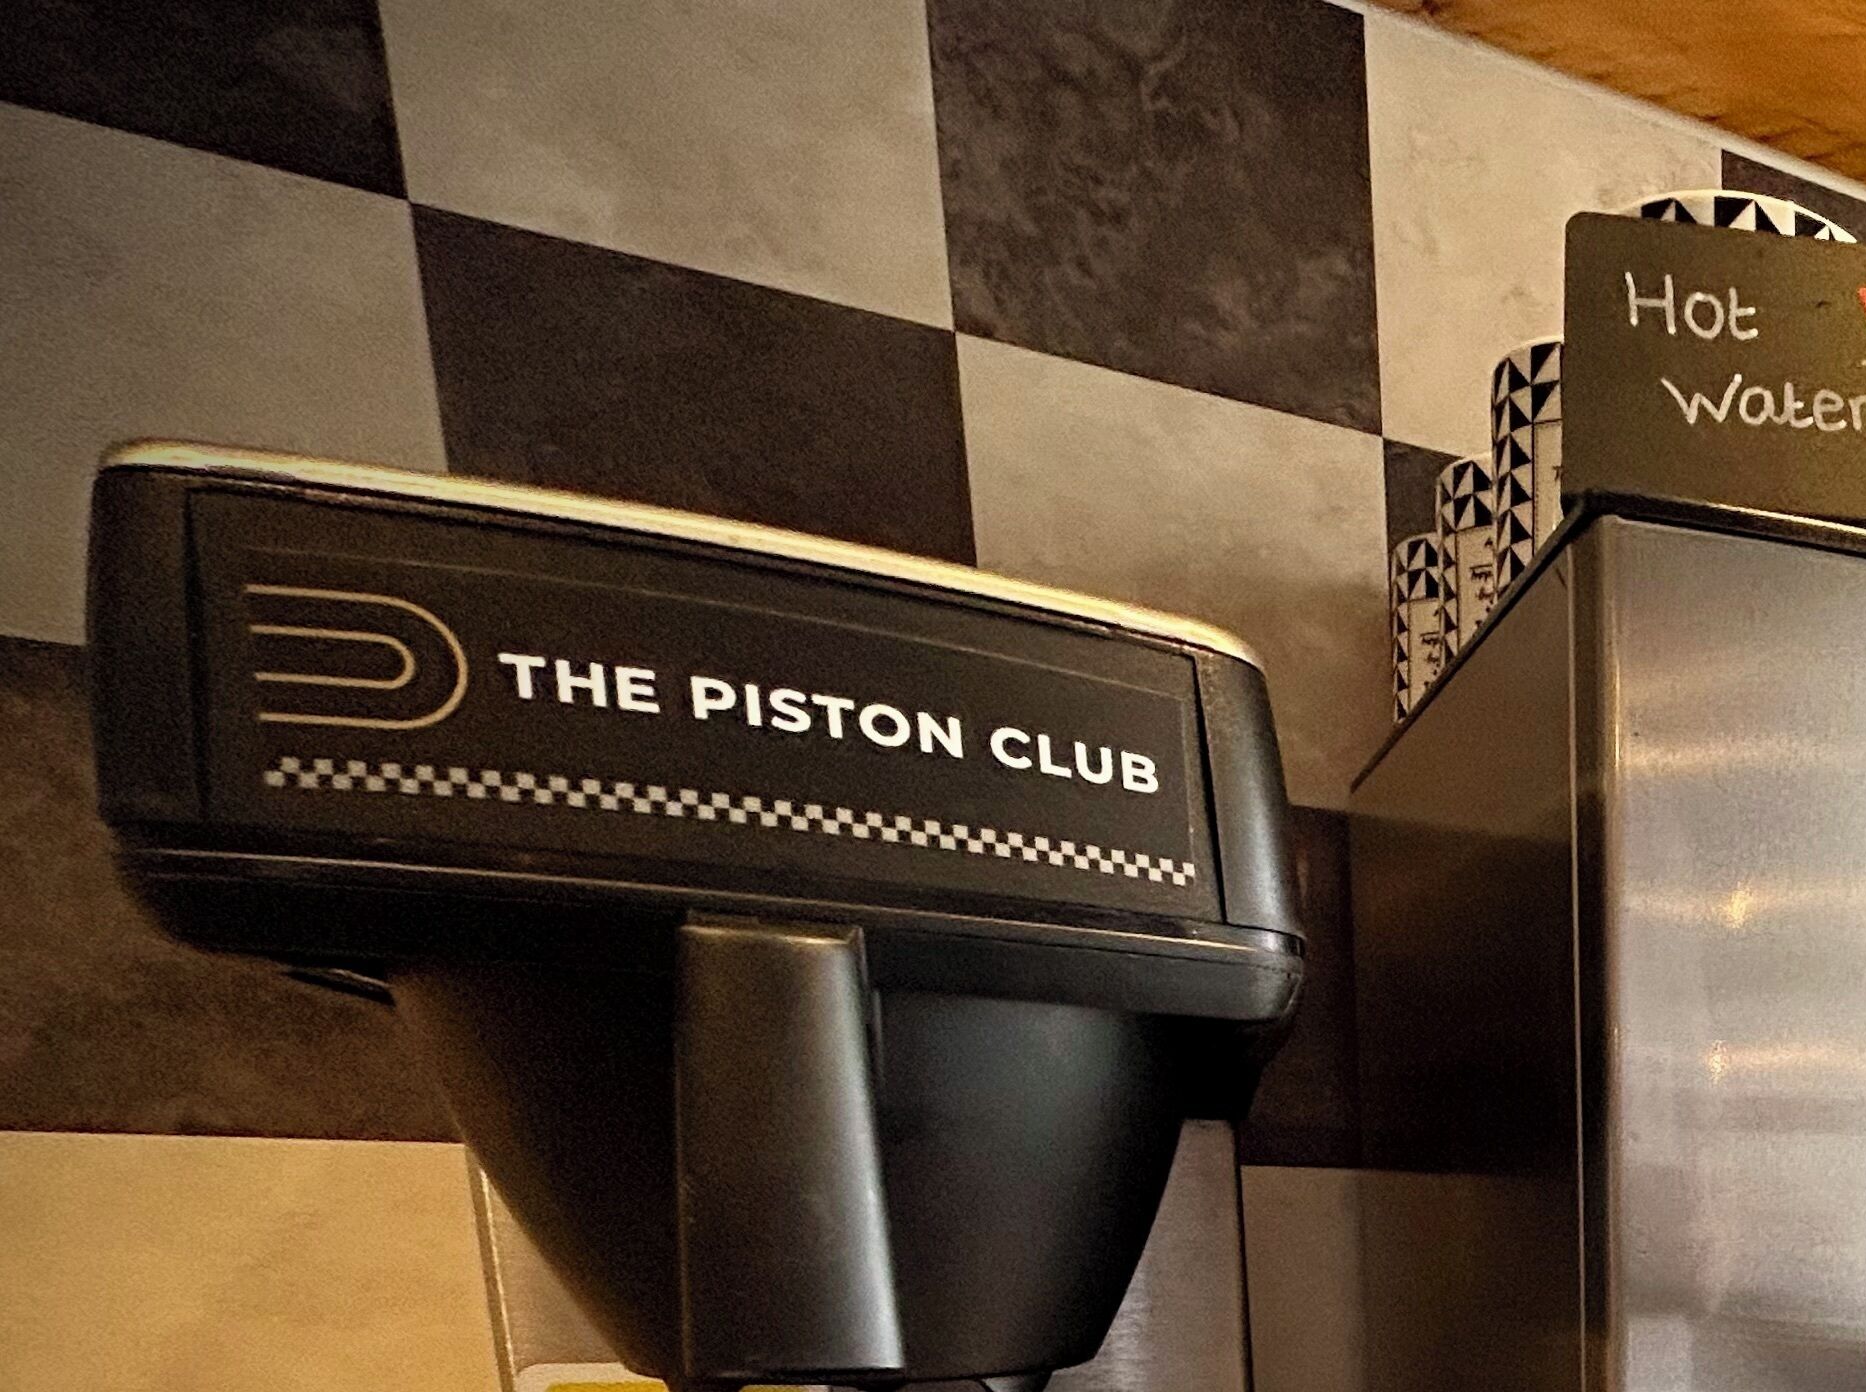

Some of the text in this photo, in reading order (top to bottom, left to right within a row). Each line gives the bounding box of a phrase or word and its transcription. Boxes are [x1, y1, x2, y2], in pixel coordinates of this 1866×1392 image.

[1624, 271, 1758, 340] Hot
[499, 652, 1159, 796] THE PISTON CLUB
